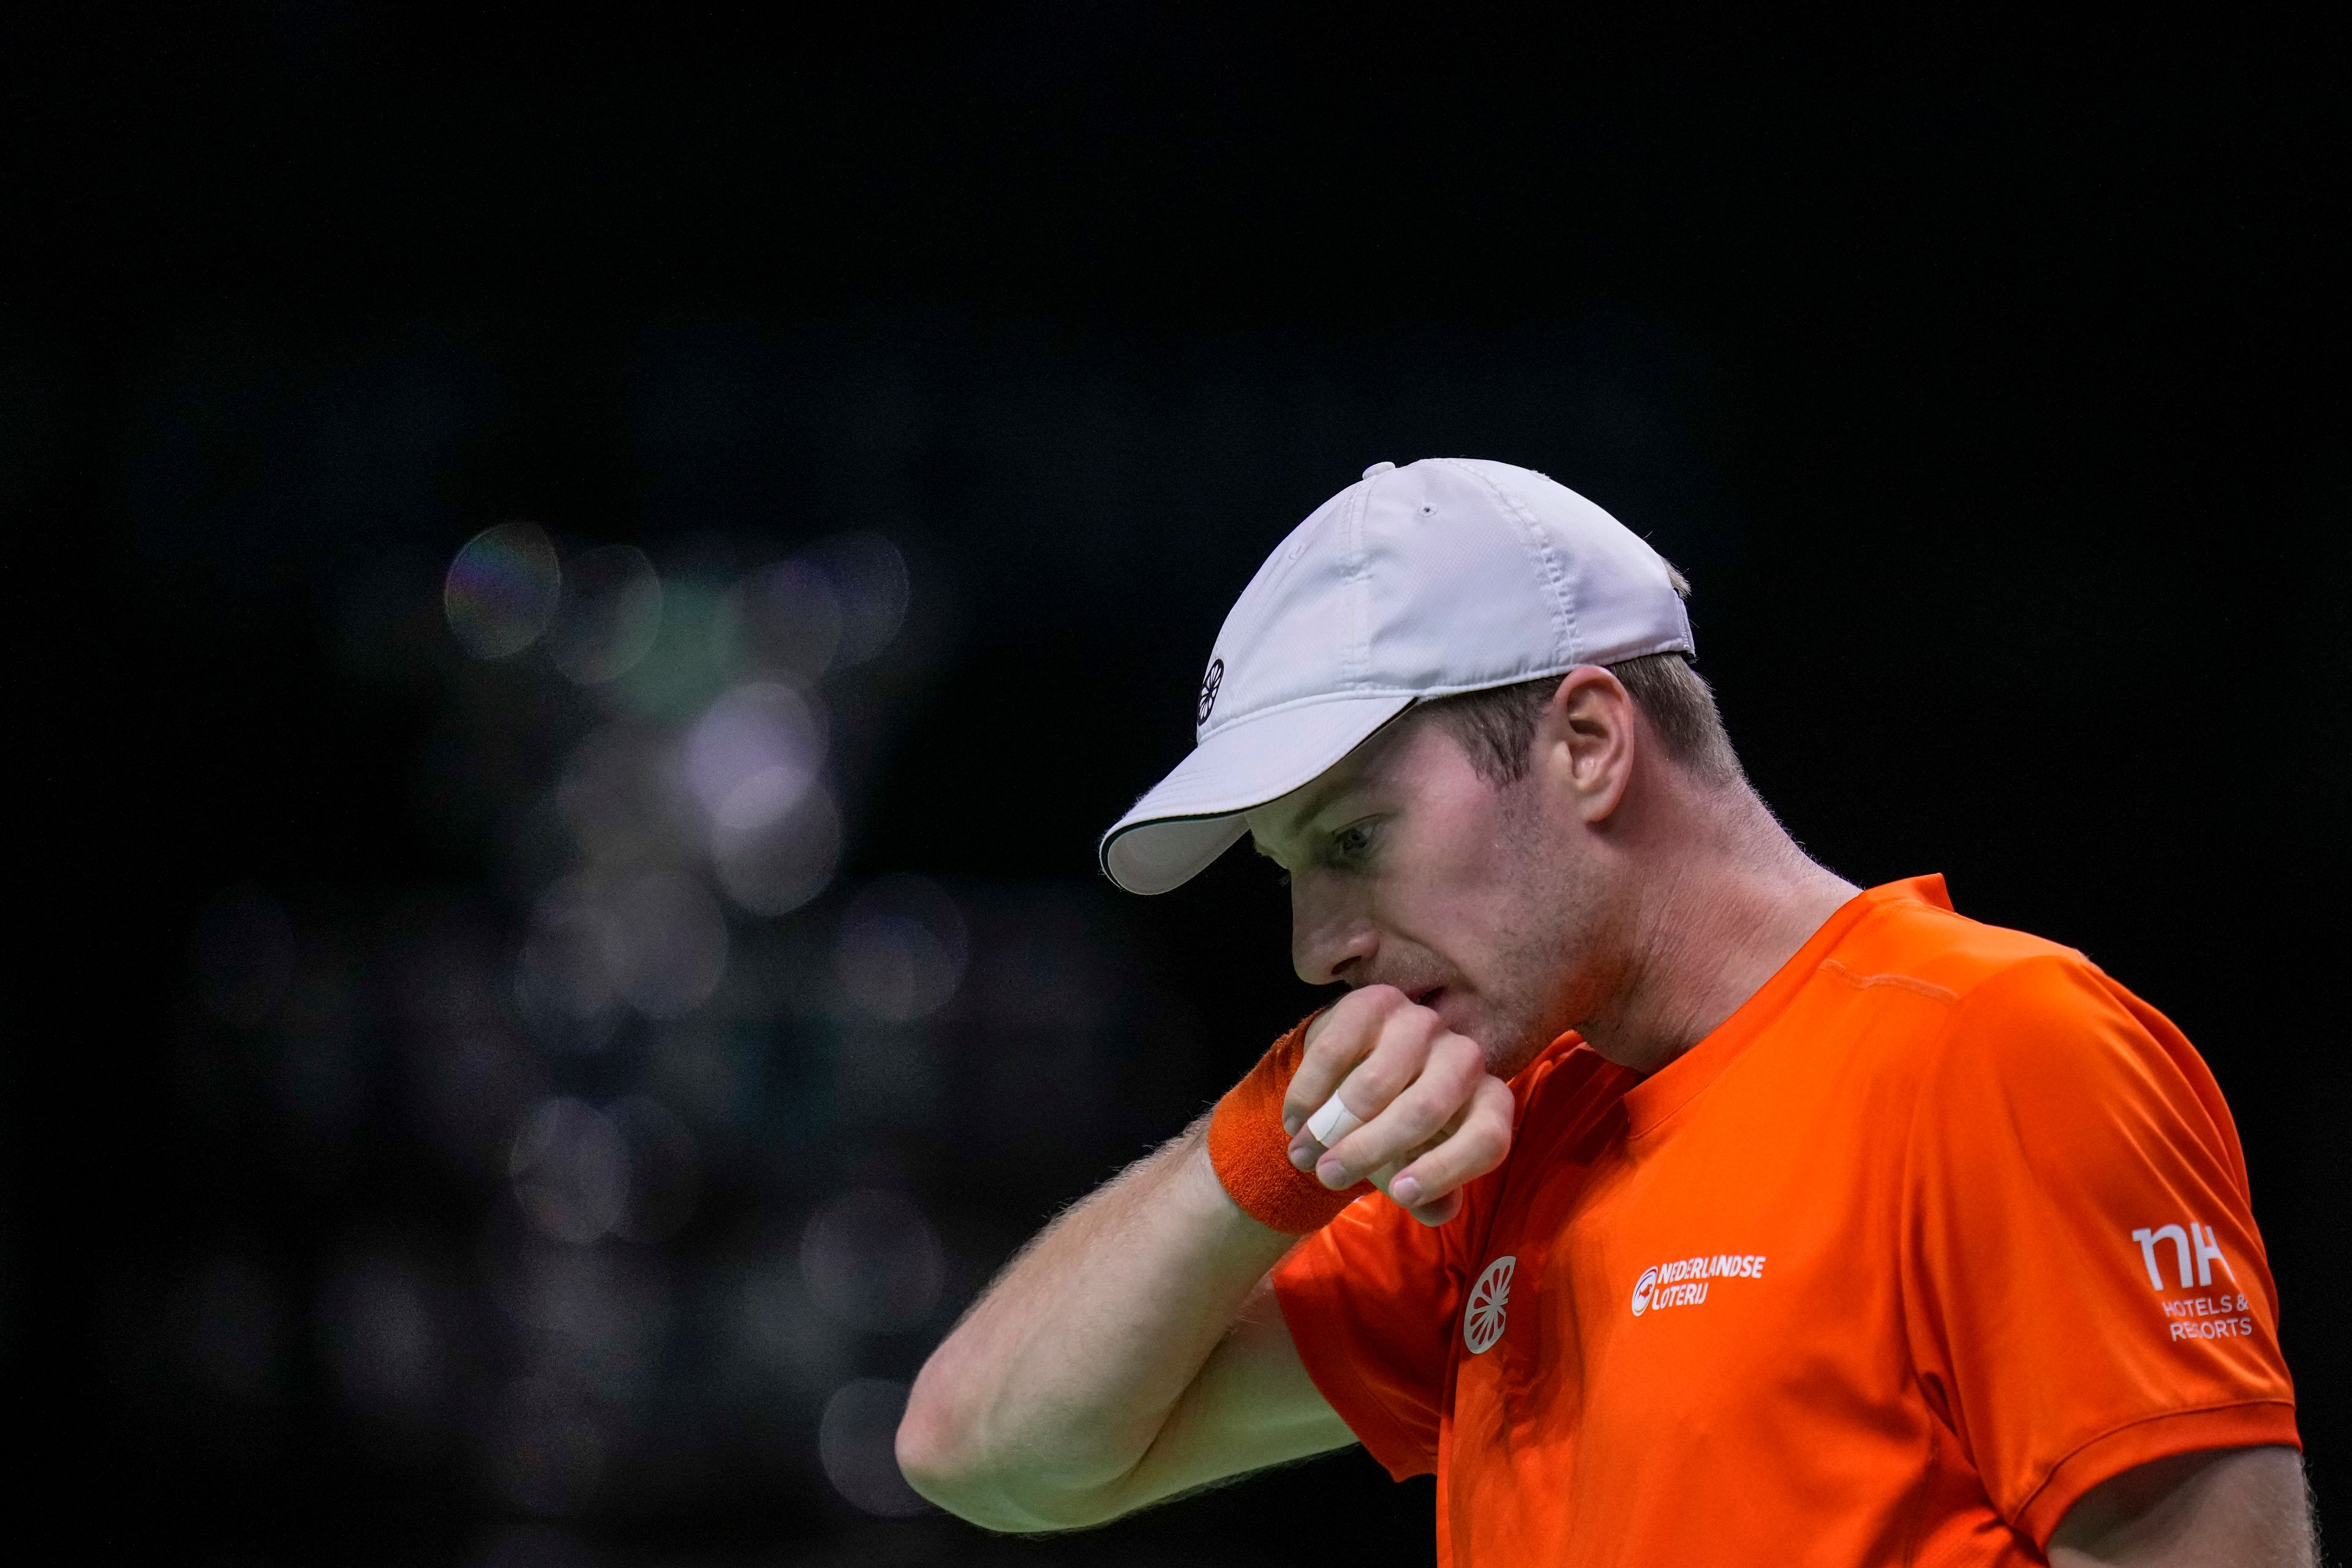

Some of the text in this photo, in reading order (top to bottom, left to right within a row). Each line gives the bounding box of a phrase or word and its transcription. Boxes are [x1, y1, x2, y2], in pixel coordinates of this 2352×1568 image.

[1657, 1254, 1766, 1284] NEDERLANDSE
[1652, 1282, 1709, 1310] LOTERIJ
[2162, 1293, 2248, 1317] HOTELS &
